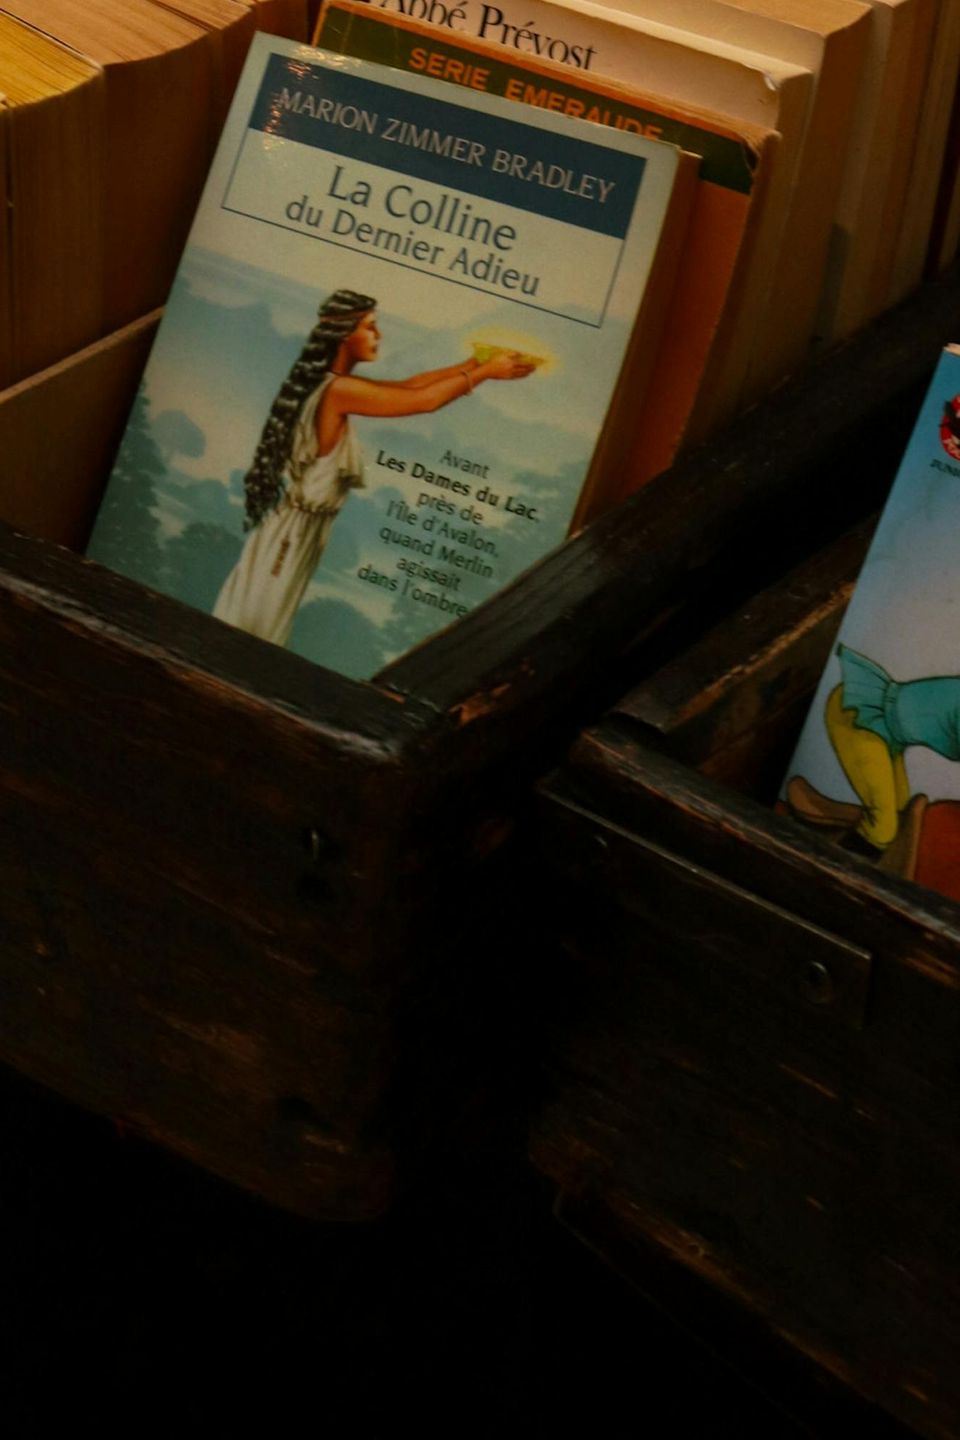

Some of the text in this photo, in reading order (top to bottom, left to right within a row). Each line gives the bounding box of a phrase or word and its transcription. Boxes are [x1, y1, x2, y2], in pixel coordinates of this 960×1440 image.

[477, 3, 598, 71] Prévost
[276, 87, 617, 204] MARION ZIMMER BRADLEY
[327, 164, 517, 251] La Colline
[285, 195, 542, 297] du Dernier Adieu
[376, 449, 407, 474] Les
[411, 462, 471, 497] Dames
[476, 487, 499, 508] du
[440, 449, 490, 480] Avant
[415, 491, 484, 526] près de
[357, 563, 398, 592] dans
[379, 526, 494, 579] quand Merlin
[396, 557, 462, 593] agissait
